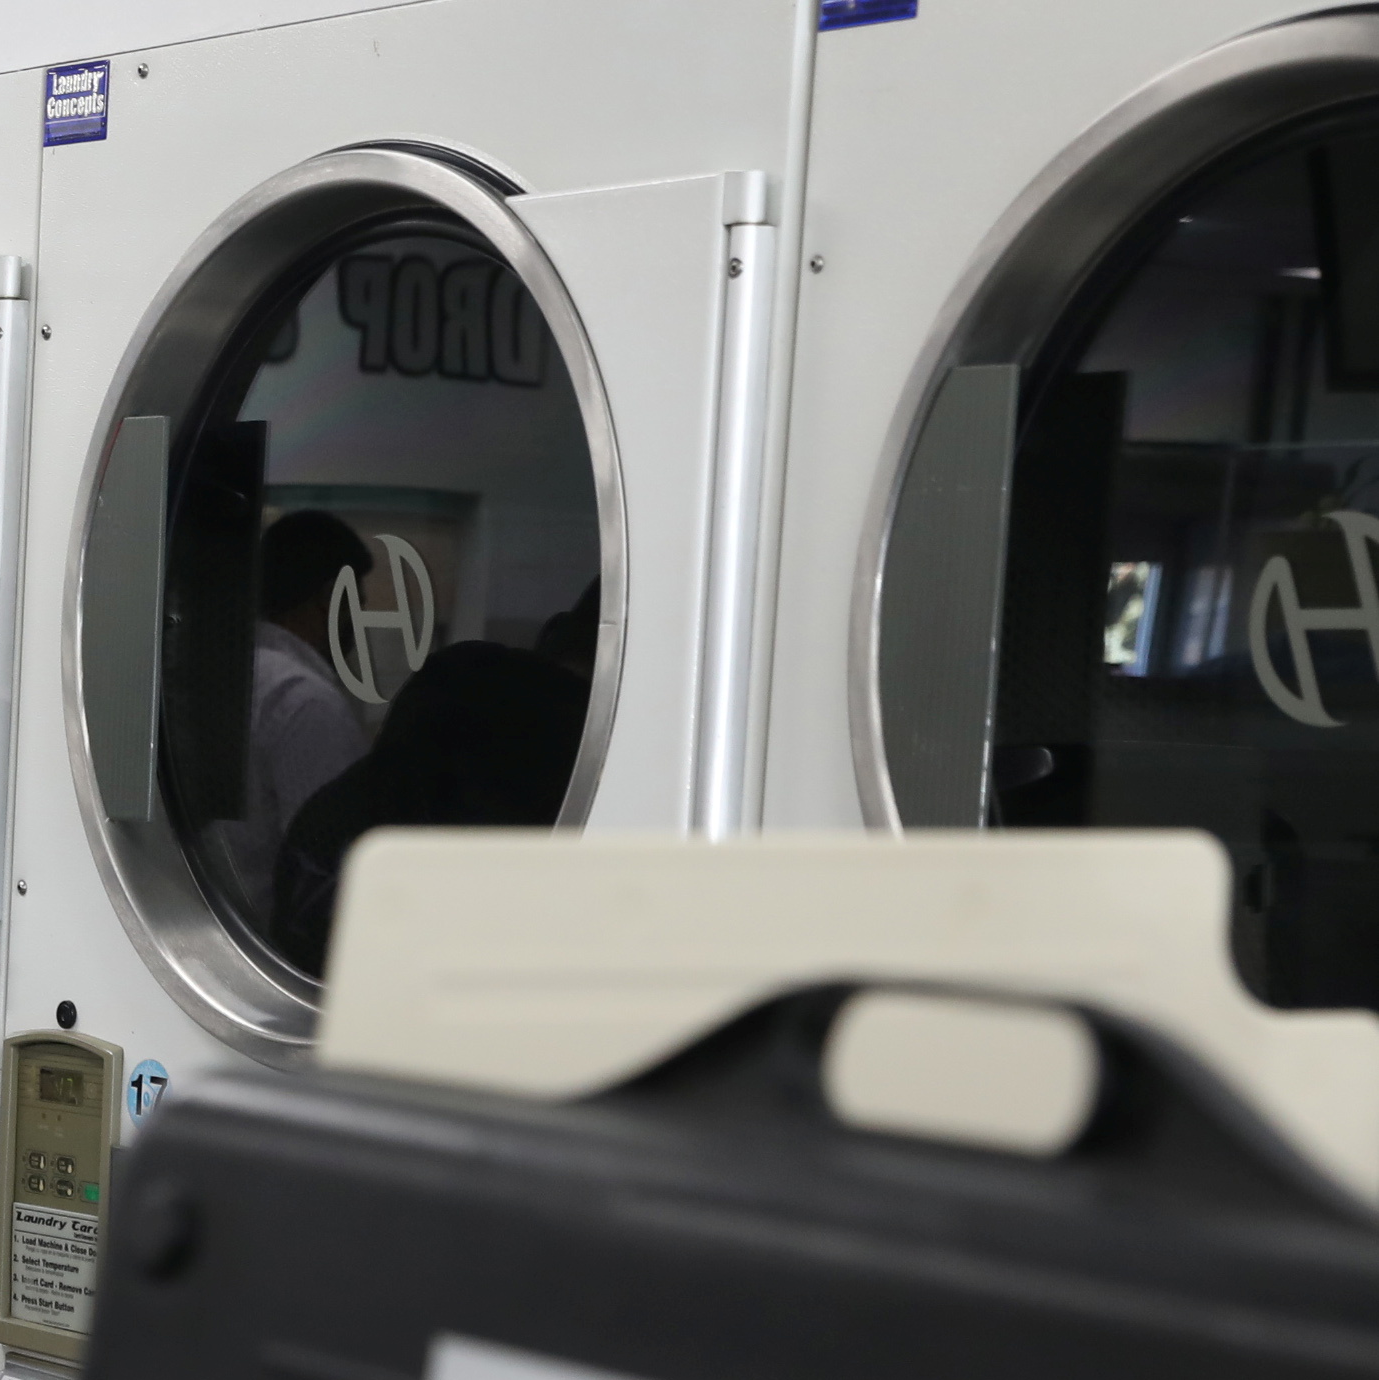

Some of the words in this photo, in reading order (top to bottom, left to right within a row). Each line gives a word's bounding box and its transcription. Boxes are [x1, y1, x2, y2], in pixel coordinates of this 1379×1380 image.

[52, 70, 104, 95] Laundry
[47, 92, 104, 119] Concepts
[131, 1074, 167, 1115] 17
[16, 1211, 67, 1230] Laundry
